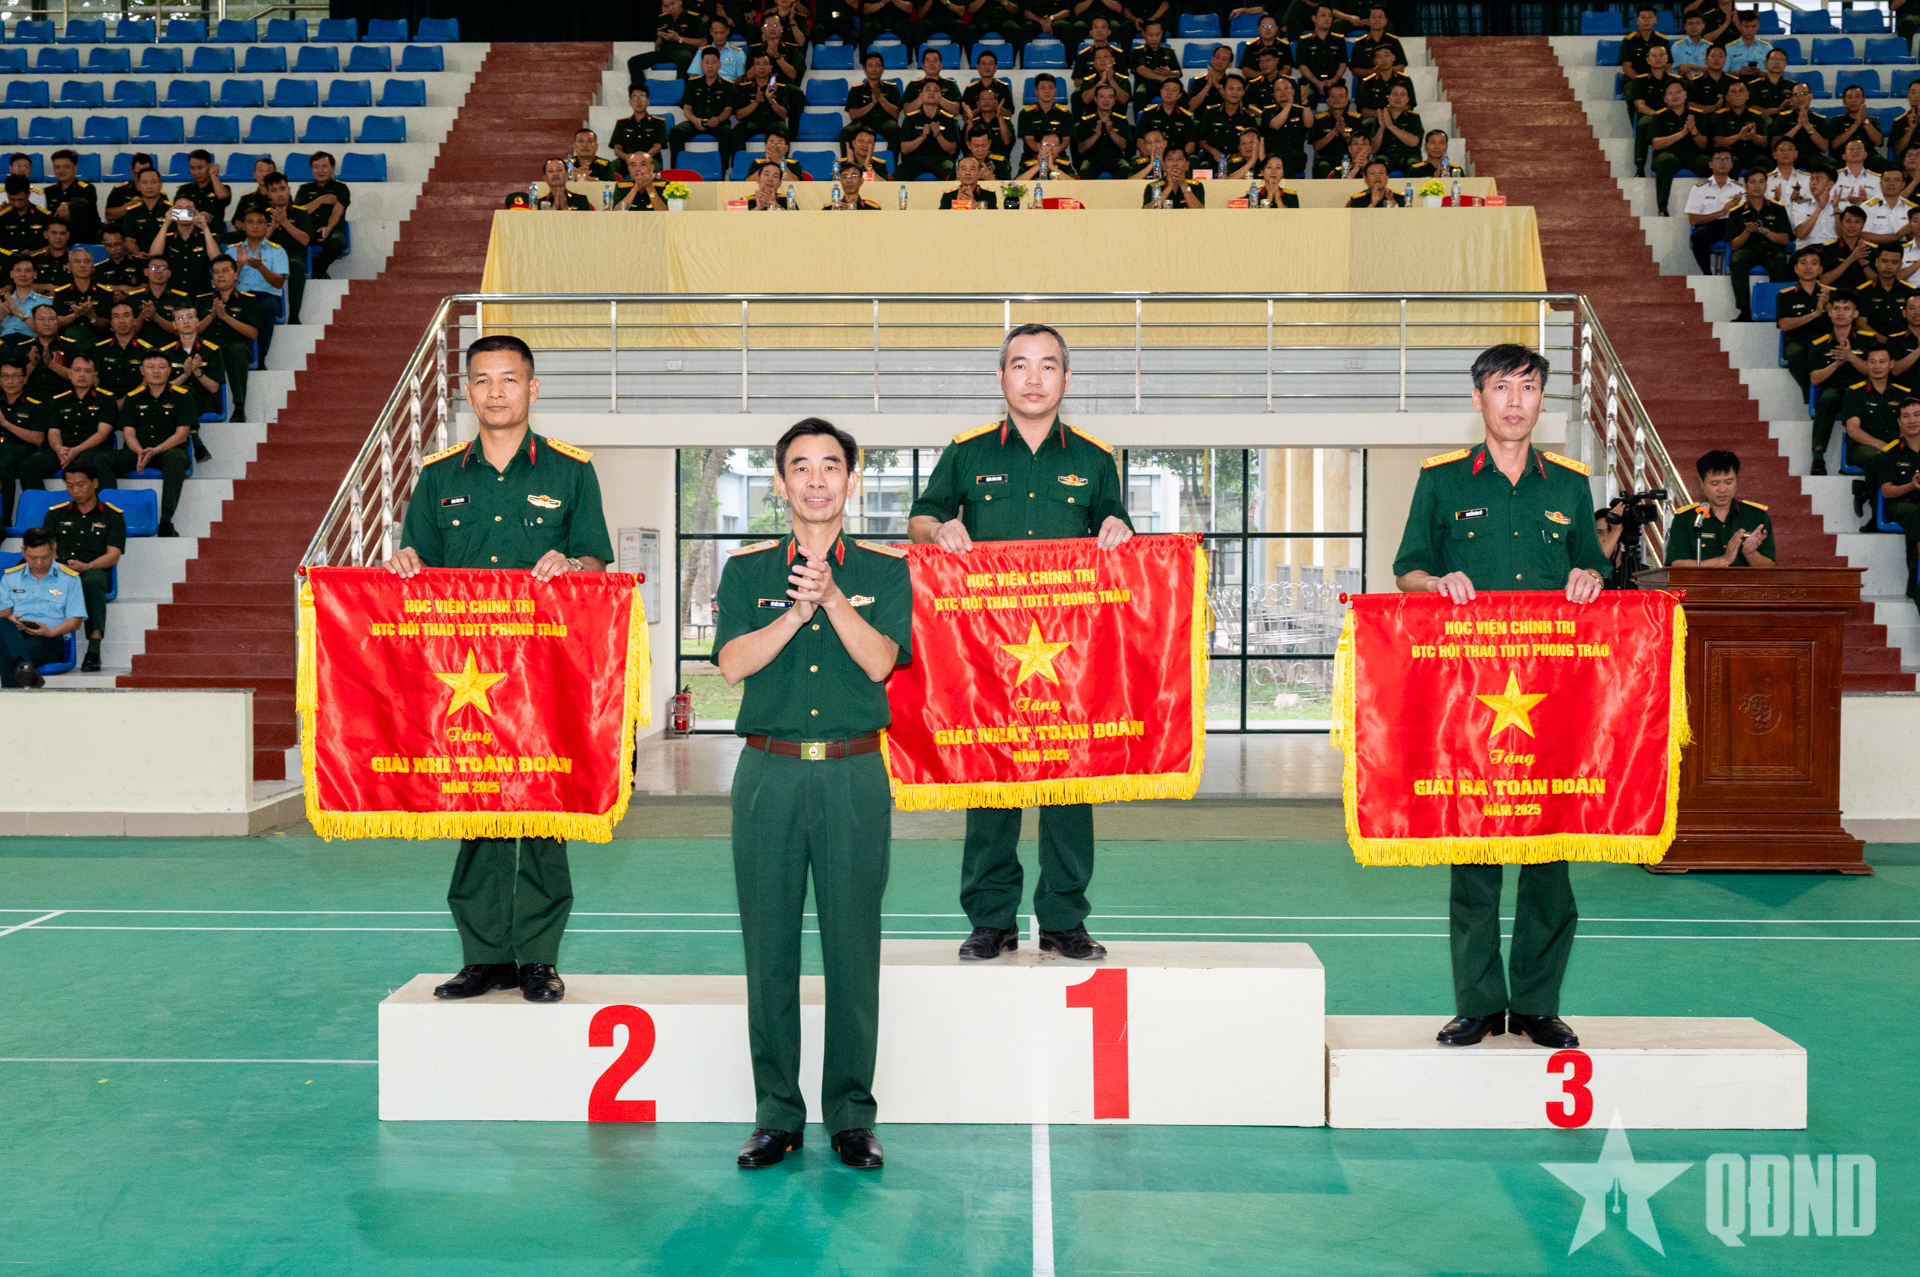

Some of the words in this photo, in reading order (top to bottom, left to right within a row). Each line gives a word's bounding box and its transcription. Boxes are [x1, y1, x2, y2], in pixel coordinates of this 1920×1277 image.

[966, 573, 994, 590] HỌC
[996, 570, 1027, 589] VIỆN
[1030, 569, 1071, 585] CHÍNH
[1074, 568, 1096, 585] TRỊ
[404, 599, 432, 616] HỌC
[435, 598, 466, 616] VIỆN
[469, 597, 511, 614] CHÍNH
[514, 599, 535, 616] TRỊ
[934, 597, 959, 611] BTC
[961, 595, 983, 612] HỘI
[985, 595, 1018, 610] THAO
[1020, 594, 1049, 608] TDTT
[1052, 591, 1096, 607] PHONG
[371, 623, 396, 636] BTC
[398, 620, 420, 638] HỘI
[421, 623, 456, 636] THAO
[458, 623, 487, 636] TDTT
[490, 622, 535, 636] PHONG
[1444, 620, 1473, 637] HỌC
[1475, 618, 1507, 637] VIỆN
[1510, 617, 1552, 634] CHÍNH
[1554, 620, 1576, 637] TRỊ
[1411, 645, 1436, 658] BTC
[1438, 642, 1460, 660] HỘI
[1462, 644, 1497, 658] THAO
[1499, 644, 1529, 658] TDTT
[1531, 643, 1574, 657] PHONG
[1015, 697, 1062, 713] Tặng
[446, 726, 494, 744] Tặng
[934, 724, 973, 745] GIẢI
[977, 720, 1031, 743] NHẤT
[1035, 720, 1089, 741] TOÀN
[1092, 716, 1145, 738] ĐOÀN
[371, 752, 410, 773] GIẢI
[455, 754, 514, 773] TOÀN
[518, 754, 573, 774] ĐOÀN
[1012, 748, 1040, 763] NĂM
[1042, 749, 1070, 762] 2025
[1488, 749, 1536, 767] Tặng
[441, 779, 469, 794] NĂM
[471, 781, 501, 793] 2025
[1413, 774, 1454, 796] GIẢI
[1458, 779, 1488, 796] BA
[1492, 774, 1548, 796] TOÀN
[1551, 773, 1606, 795] ĐOÀN
[1483, 802, 1512, 816] NĂM
[1514, 803, 1542, 816] 2025
[1065, 968, 1130, 1120] 1
[588, 1004, 656, 1122] 2
[1545, 1049, 1594, 1128] 3
